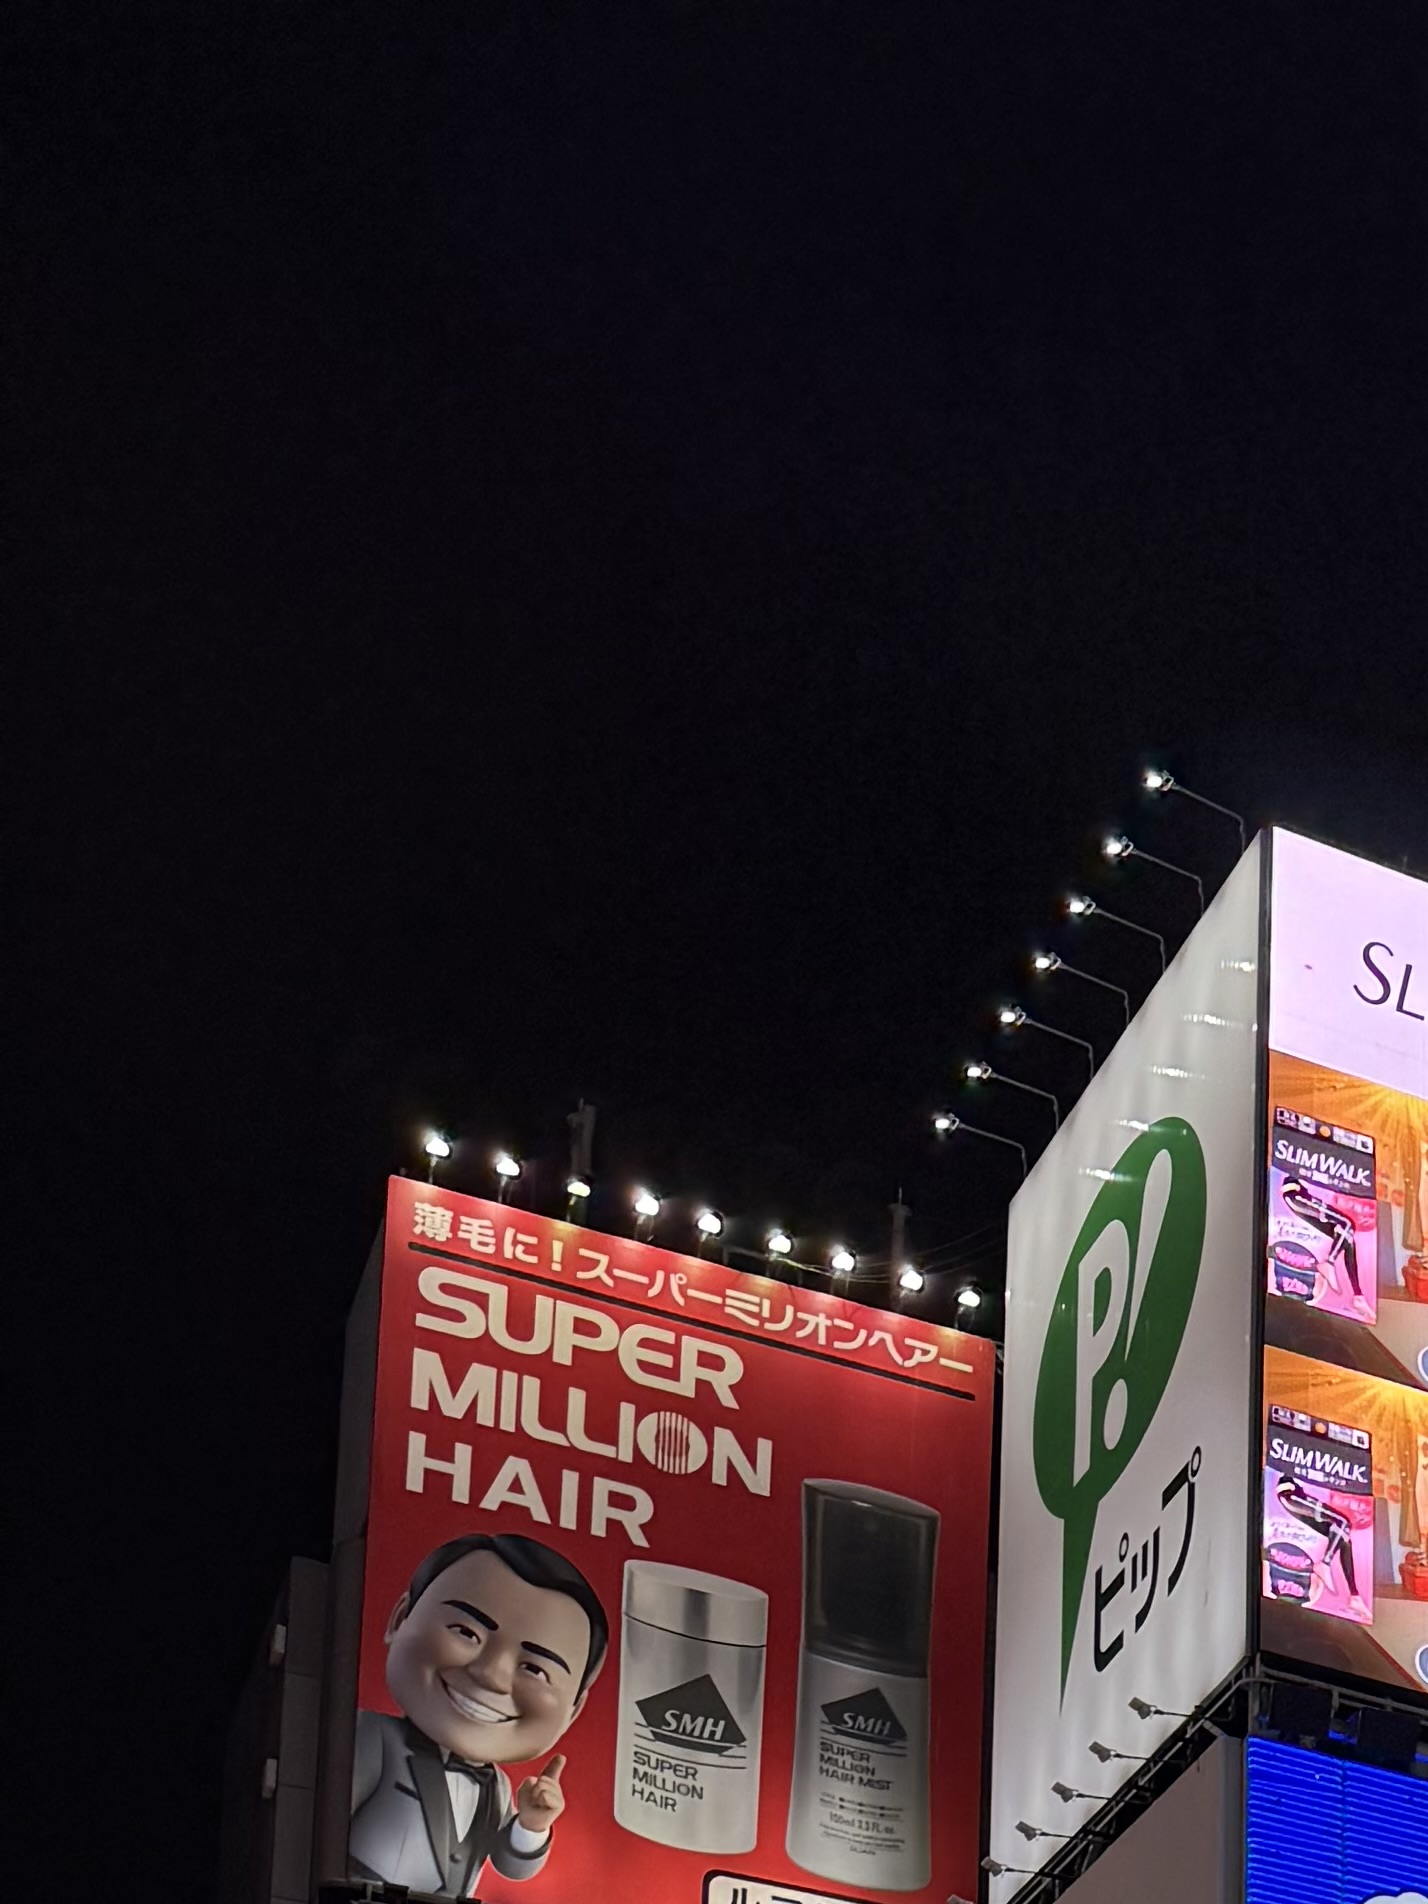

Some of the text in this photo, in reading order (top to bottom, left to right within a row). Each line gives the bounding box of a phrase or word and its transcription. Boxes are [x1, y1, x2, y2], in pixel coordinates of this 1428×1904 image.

[414, 1266, 745, 1410] SUPER
[410, 1350, 773, 1498] MILLION
[404, 1430, 655, 1549] HAIR
[1094, 1446, 1203, 1671] ピップ
[662, 1709, 726, 1741] SMH
[842, 1711, 892, 1736] SMH
[633, 1750, 698, 1782] SUPER
[631, 1783, 678, 1812] HAIR
[632, 1767, 705, 1801] MILLION
